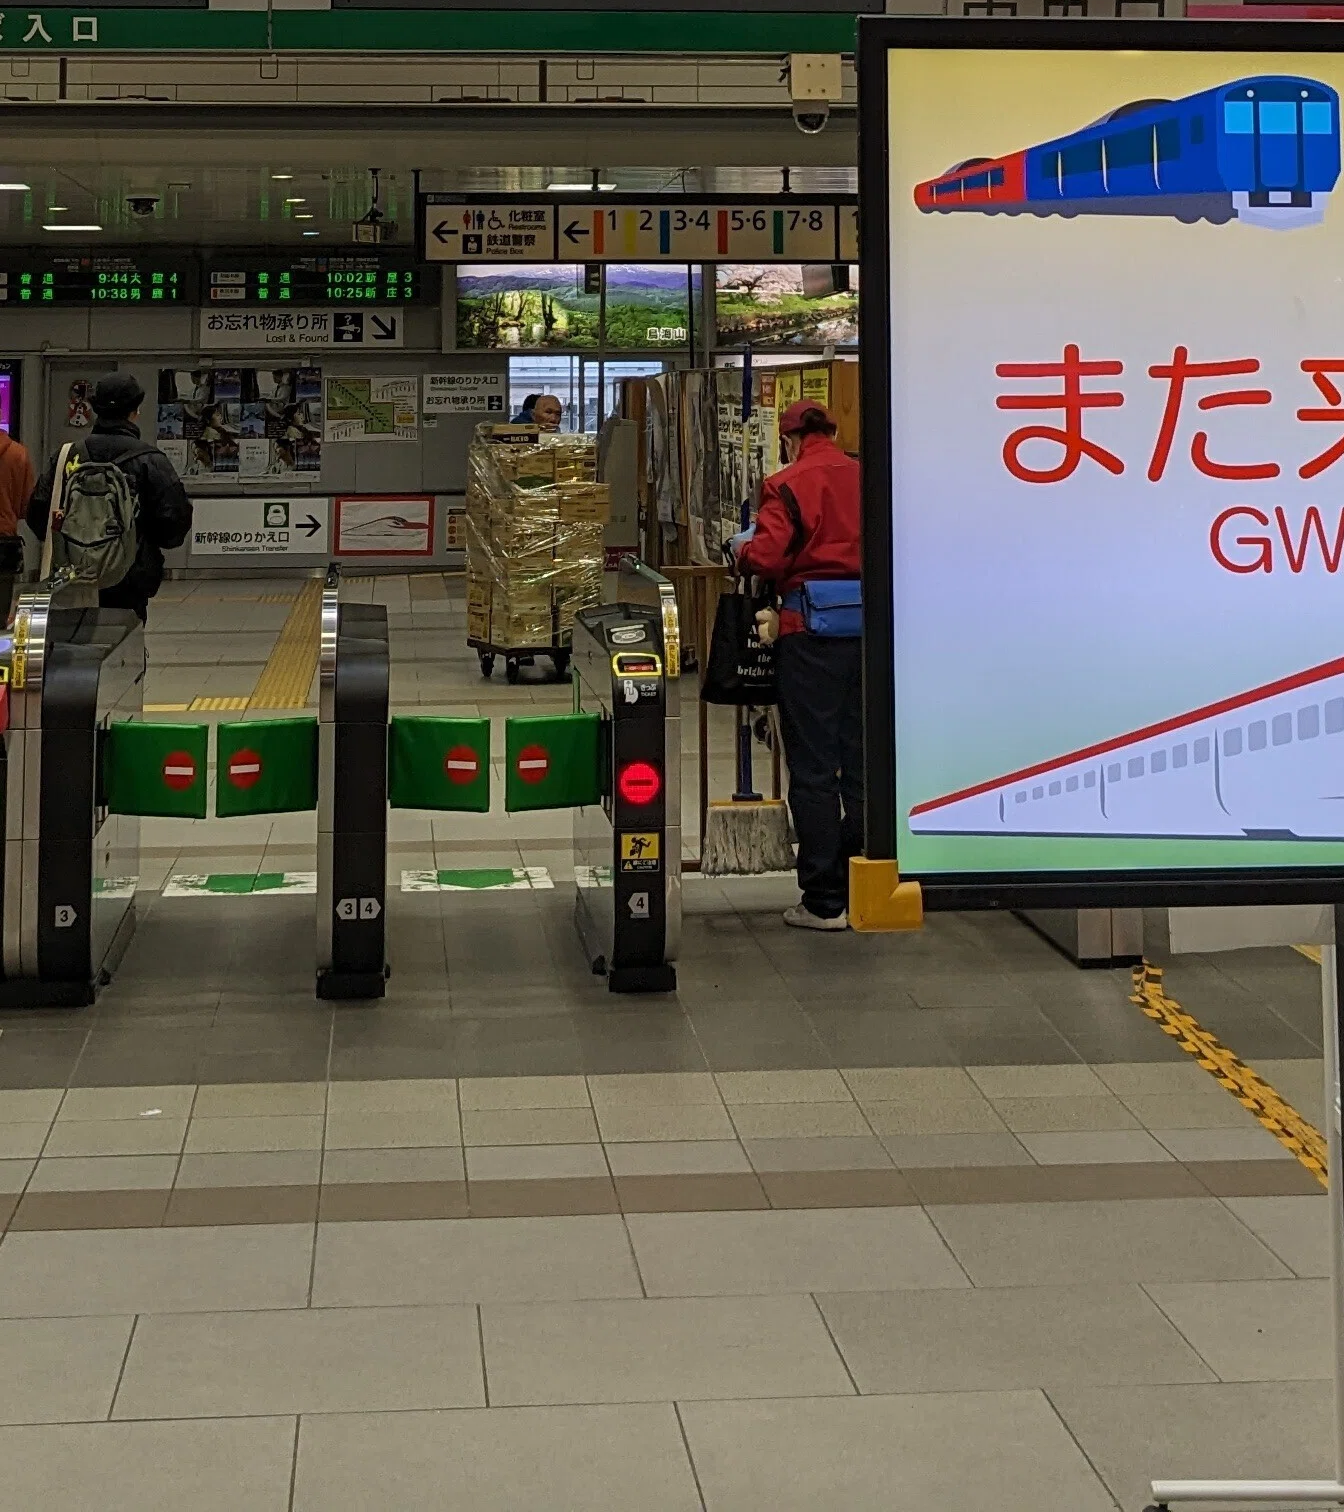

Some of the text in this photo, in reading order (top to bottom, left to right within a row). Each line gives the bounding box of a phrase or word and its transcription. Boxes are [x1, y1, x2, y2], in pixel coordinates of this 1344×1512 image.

[608, 210, 653, 231] 1 2
[207, 313, 328, 331] お忘れ物承り所
[266, 333, 329, 342] Lost Found
